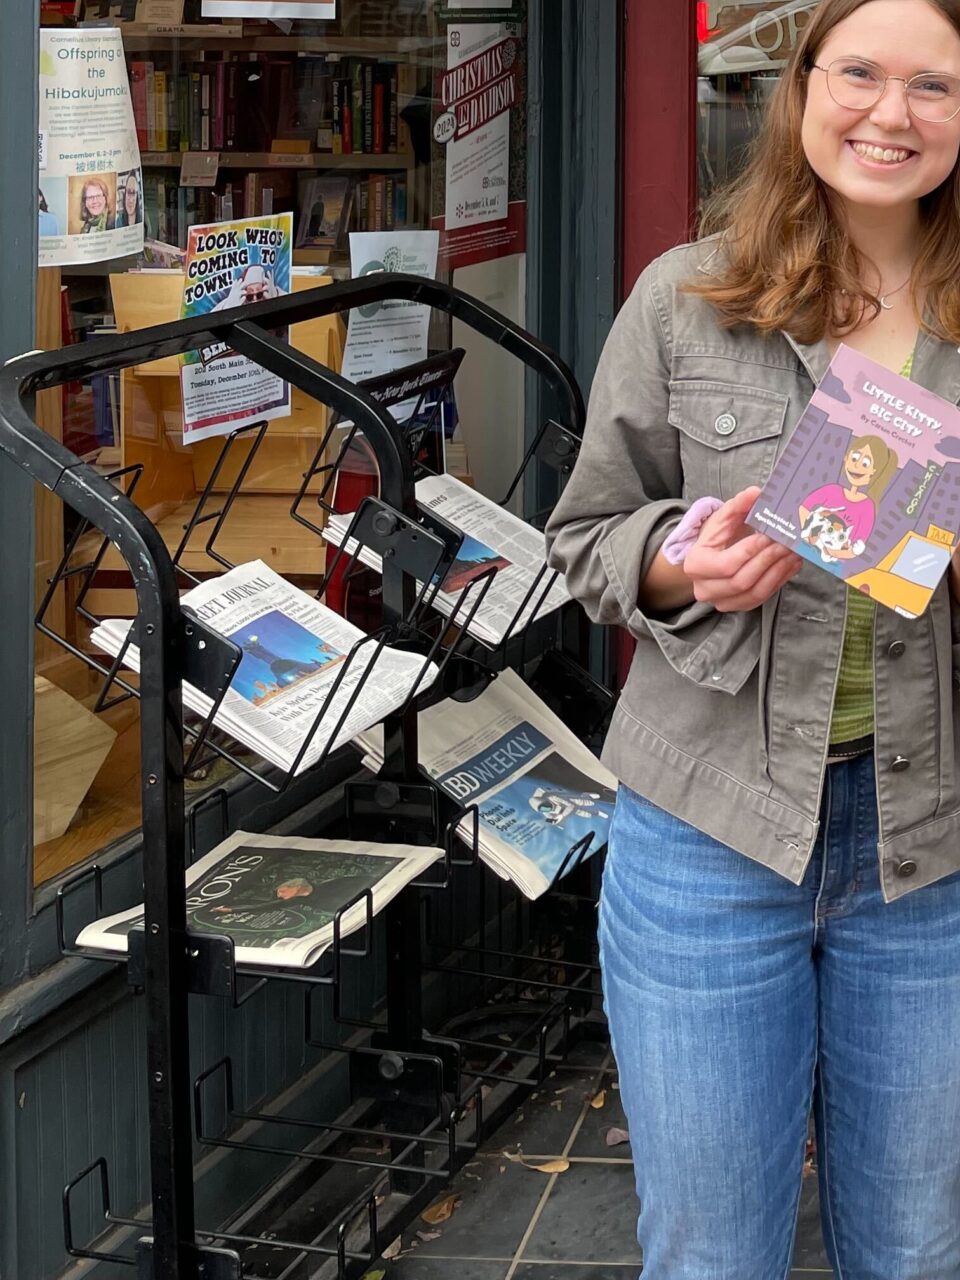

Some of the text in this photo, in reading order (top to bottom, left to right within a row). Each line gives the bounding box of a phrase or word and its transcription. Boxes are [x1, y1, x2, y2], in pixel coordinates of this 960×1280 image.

[750, 7, 812, 53] OP
[57, 46, 115, 62] Offspring
[87, 67, 106, 79] the
[441, 45, 503, 107] CHRISTMAS
[470, 72, 516, 132] DAVIDSON
[59, 151, 96, 160] December
[196, 228, 284, 255] LOOK WHO'S
[187, 248, 277, 280] COMING TO
[184, 270, 234, 306] TOWN!
[208, 359, 245, 374] South Main
[190, 372, 248, 389] Tuesday, December
[382, 384, 401, 399] New
[399, 377, 419, 399] York
[860, 413, 870, 424] By
[862, 381, 943, 435] LITTLE KITTY,
[869, 403, 924, 438] BIG CITY
[906, 464, 937, 516] CHICAGO
[929, 526, 951, 544] TAXI
[221, 577, 276, 605] JOURNAL
[440, 731, 537, 800] IBD WEEKLY
[479, 803, 505, 820] Phones
[488, 812, 503, 826] Dial
[495, 817, 518, 833] Space
